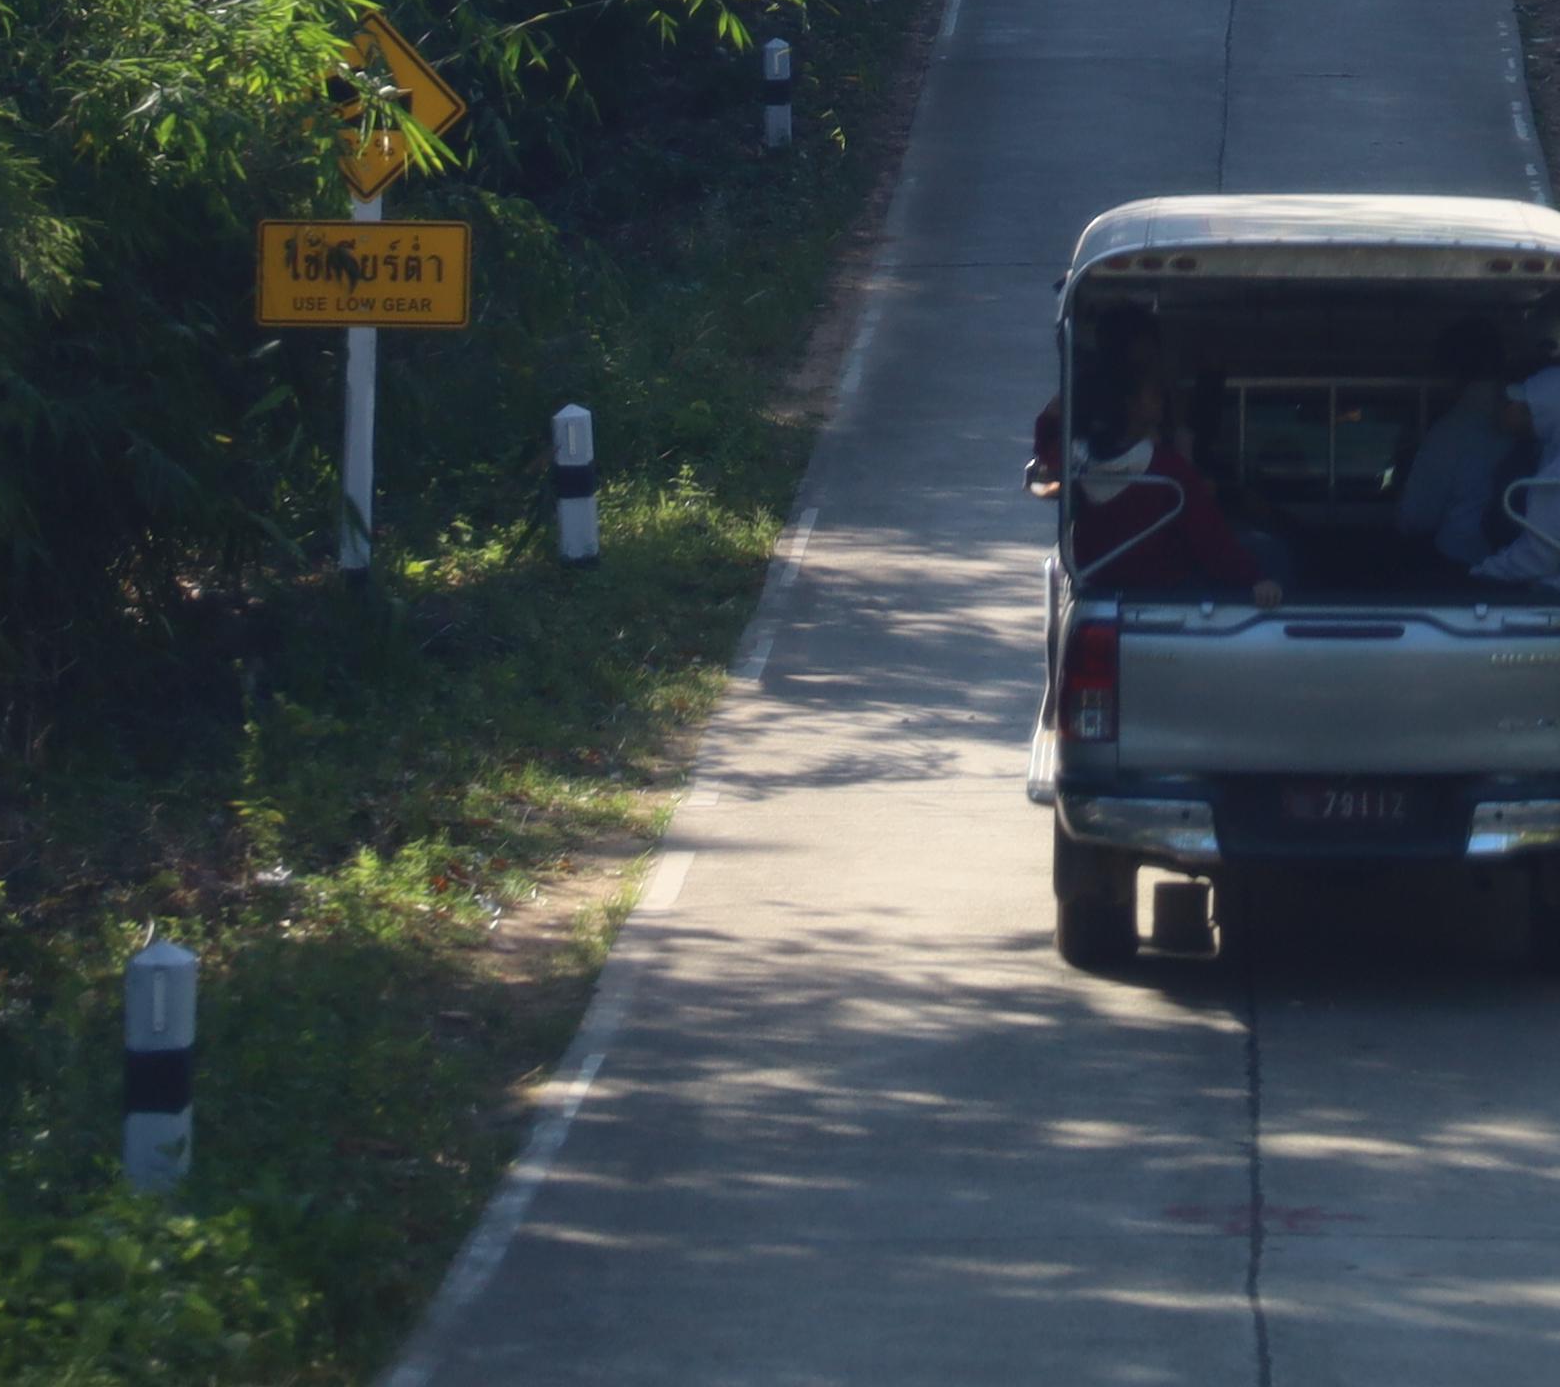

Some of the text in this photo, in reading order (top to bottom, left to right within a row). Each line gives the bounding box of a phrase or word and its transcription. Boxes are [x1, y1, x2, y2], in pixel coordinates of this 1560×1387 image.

[292, 297, 432, 312] USE LOW GEAR
